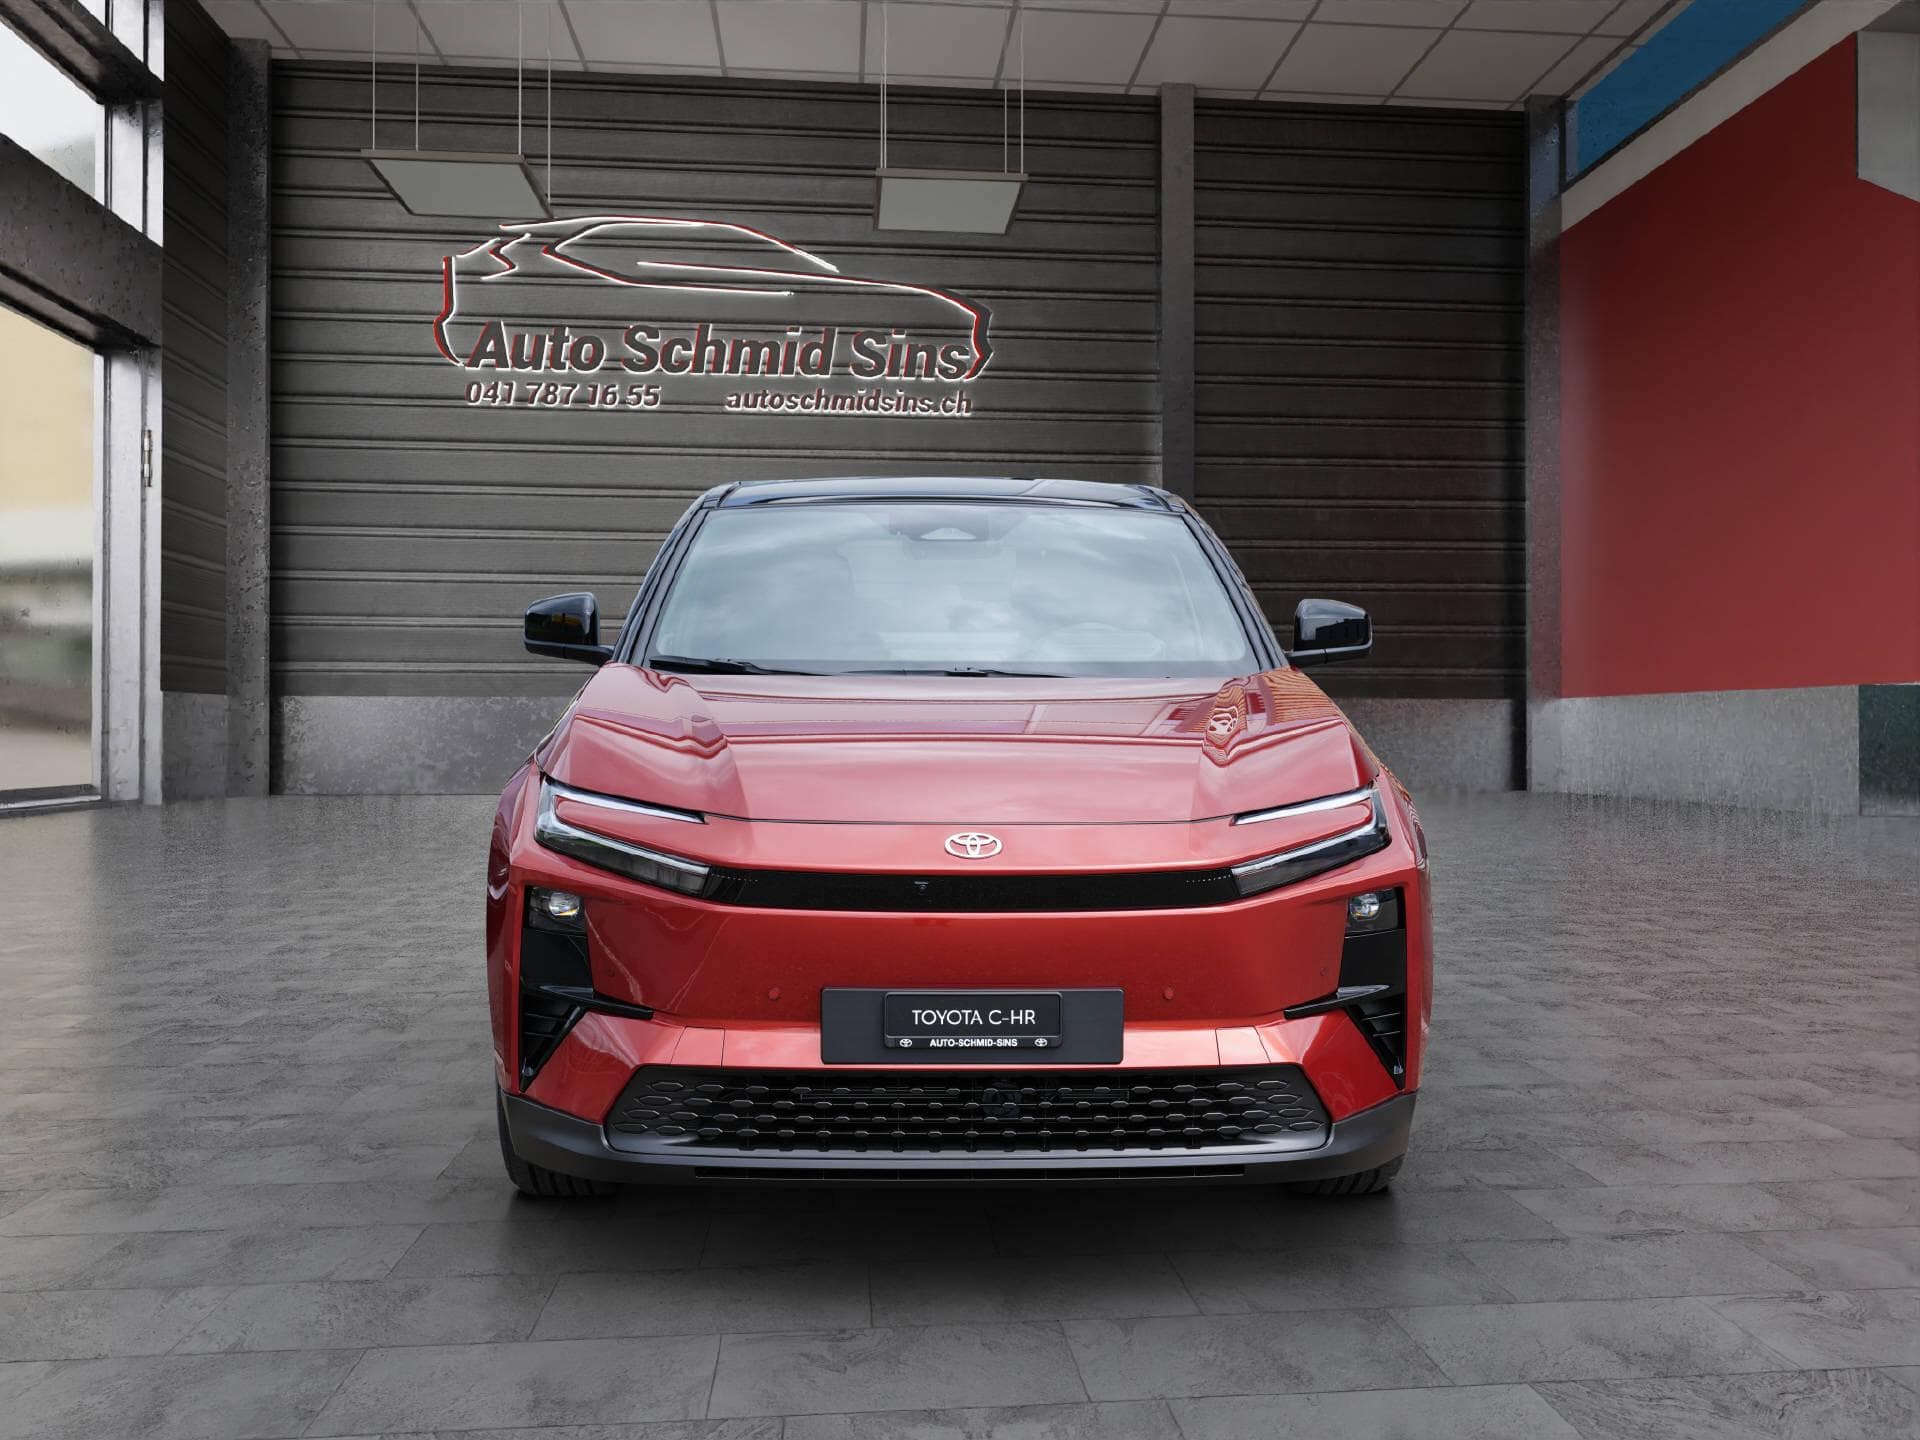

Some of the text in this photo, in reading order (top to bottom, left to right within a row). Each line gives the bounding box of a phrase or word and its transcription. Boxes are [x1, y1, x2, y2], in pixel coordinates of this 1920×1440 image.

[463, 322, 971, 382] Auto Schmid Sins
[466, 381, 661, 409] 041 787 16 55
[726, 388, 973, 417] autoschmidsins.ch
[912, 1009, 1036, 1025] TOYOTA C-HR
[929, 1038, 1018, 1048] AUTO-SCHMID-SINS
